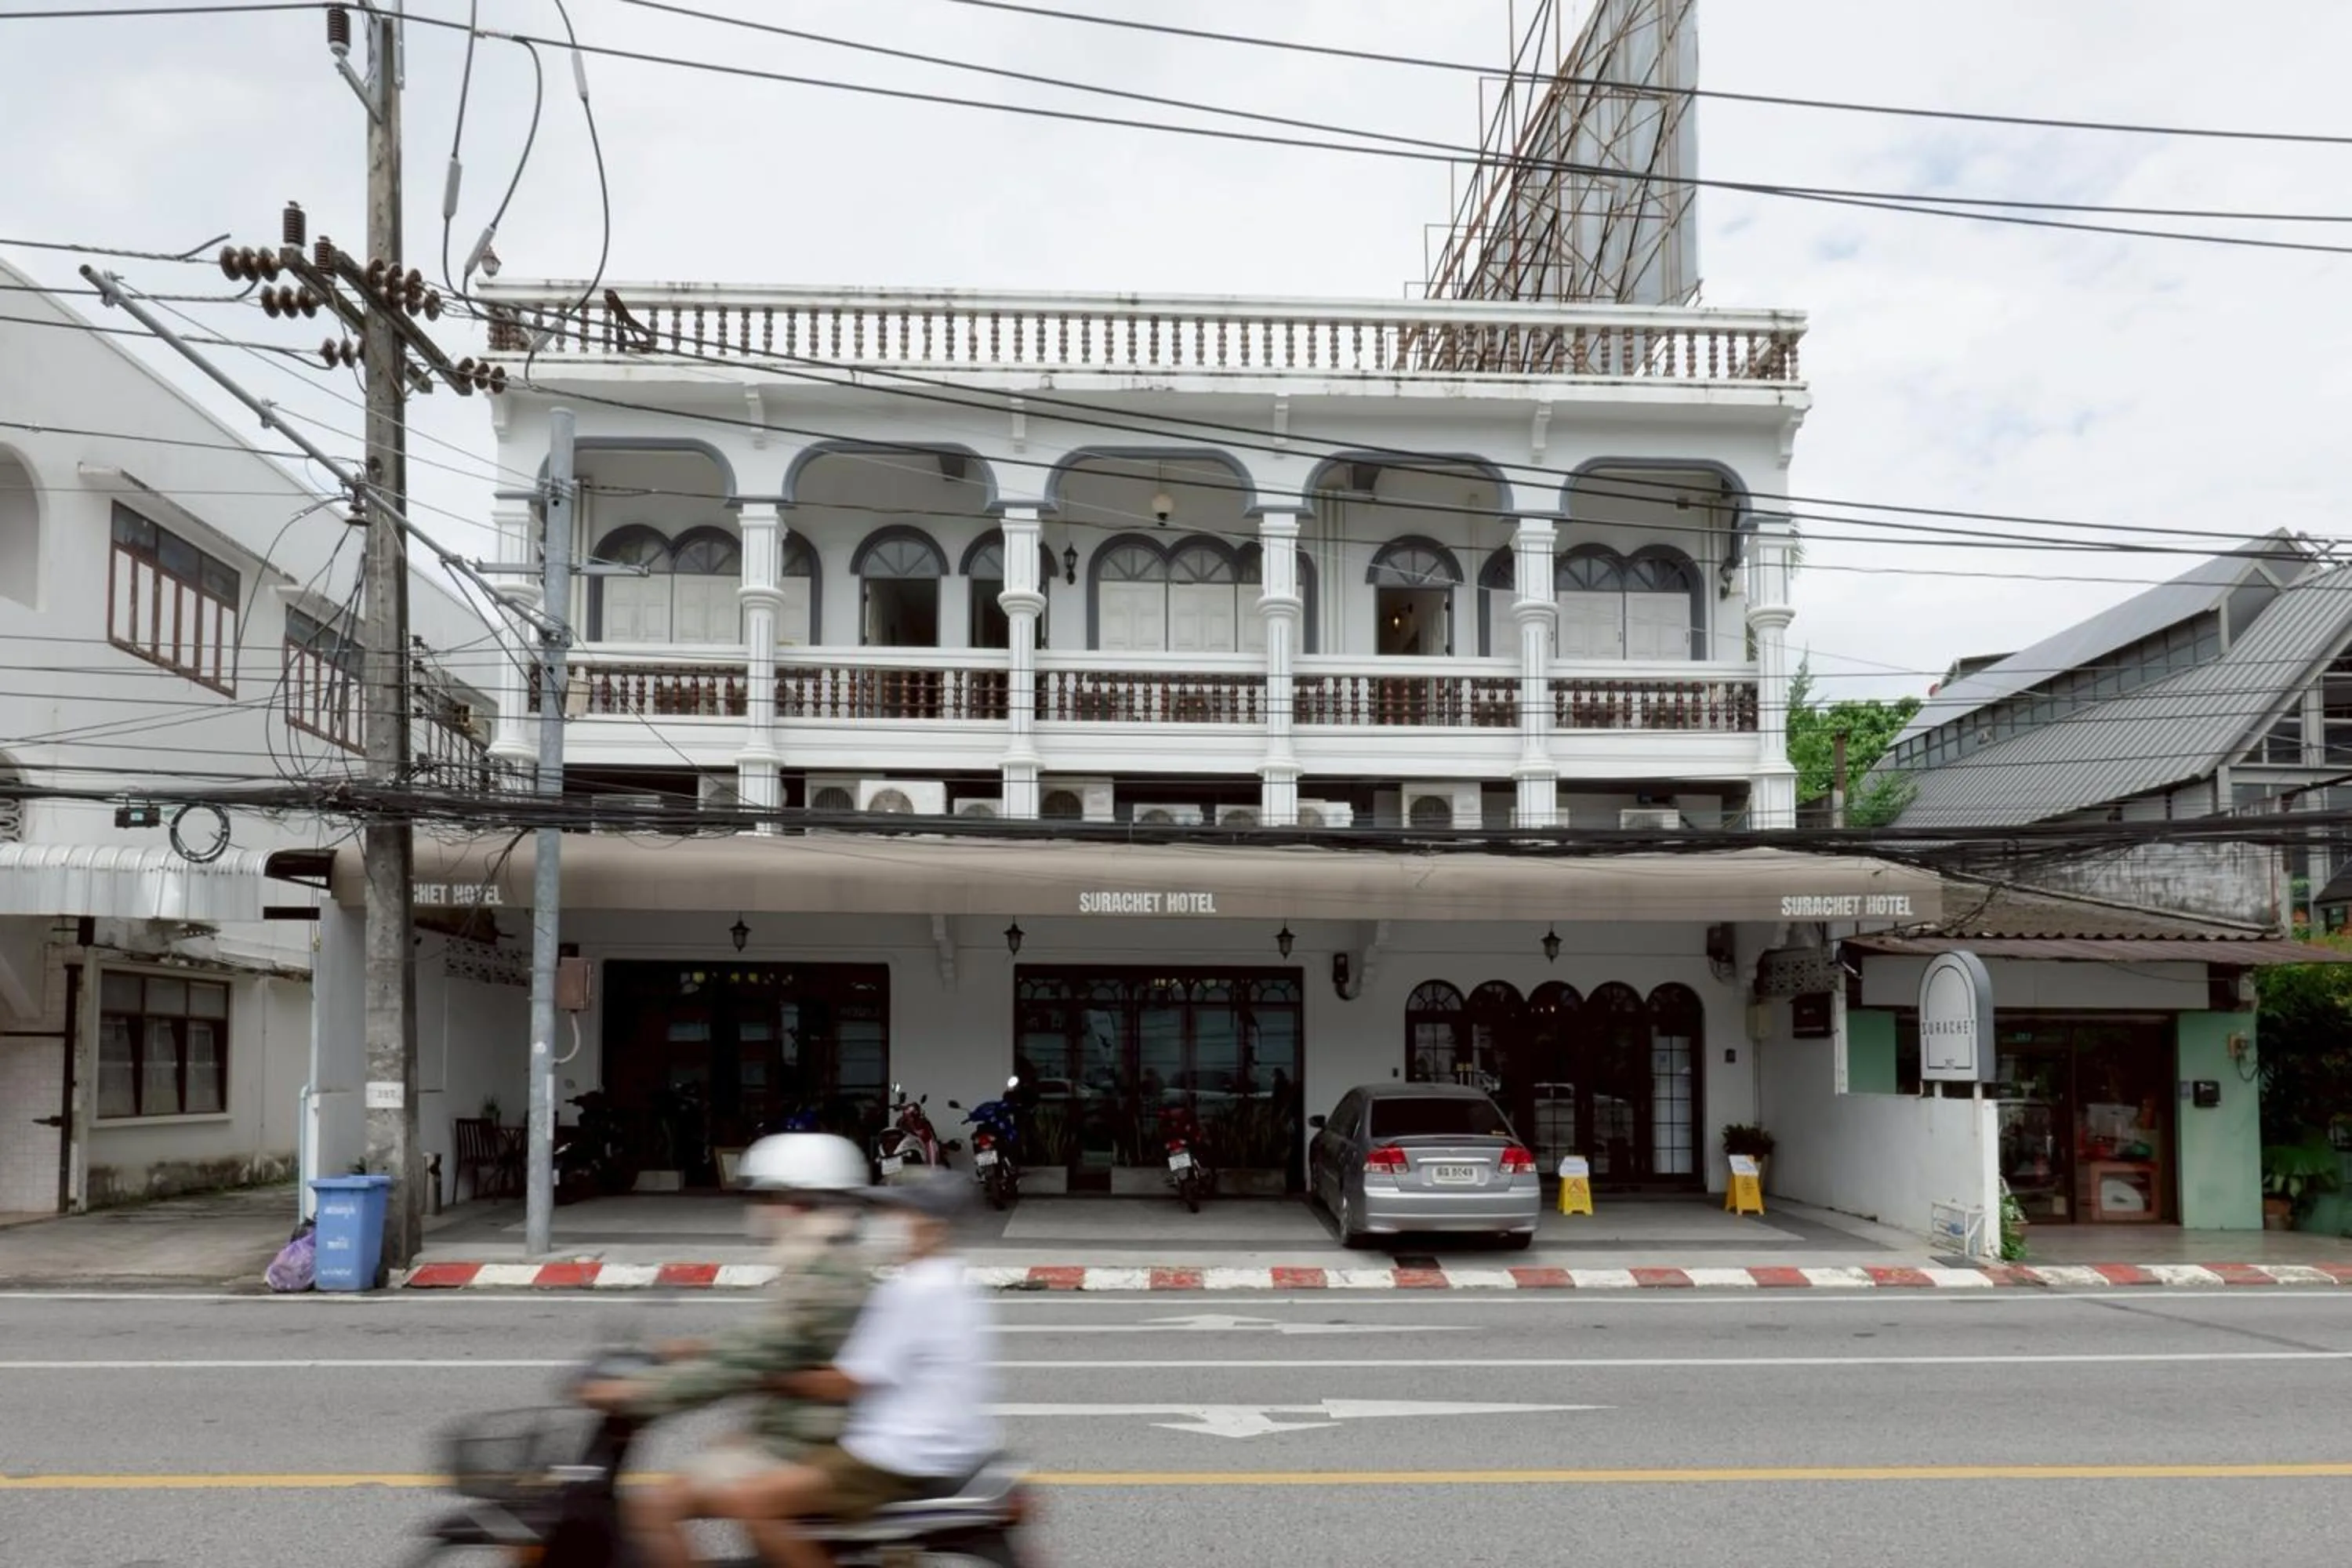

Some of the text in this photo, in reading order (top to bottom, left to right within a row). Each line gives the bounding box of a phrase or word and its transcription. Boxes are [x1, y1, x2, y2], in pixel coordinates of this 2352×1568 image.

[1079, 891, 1217, 913] SURACHET HOTEL
[1781, 895, 1914, 916] SURACHET HOTEL
[1922, 1020, 1975, 1036] SURACHET
